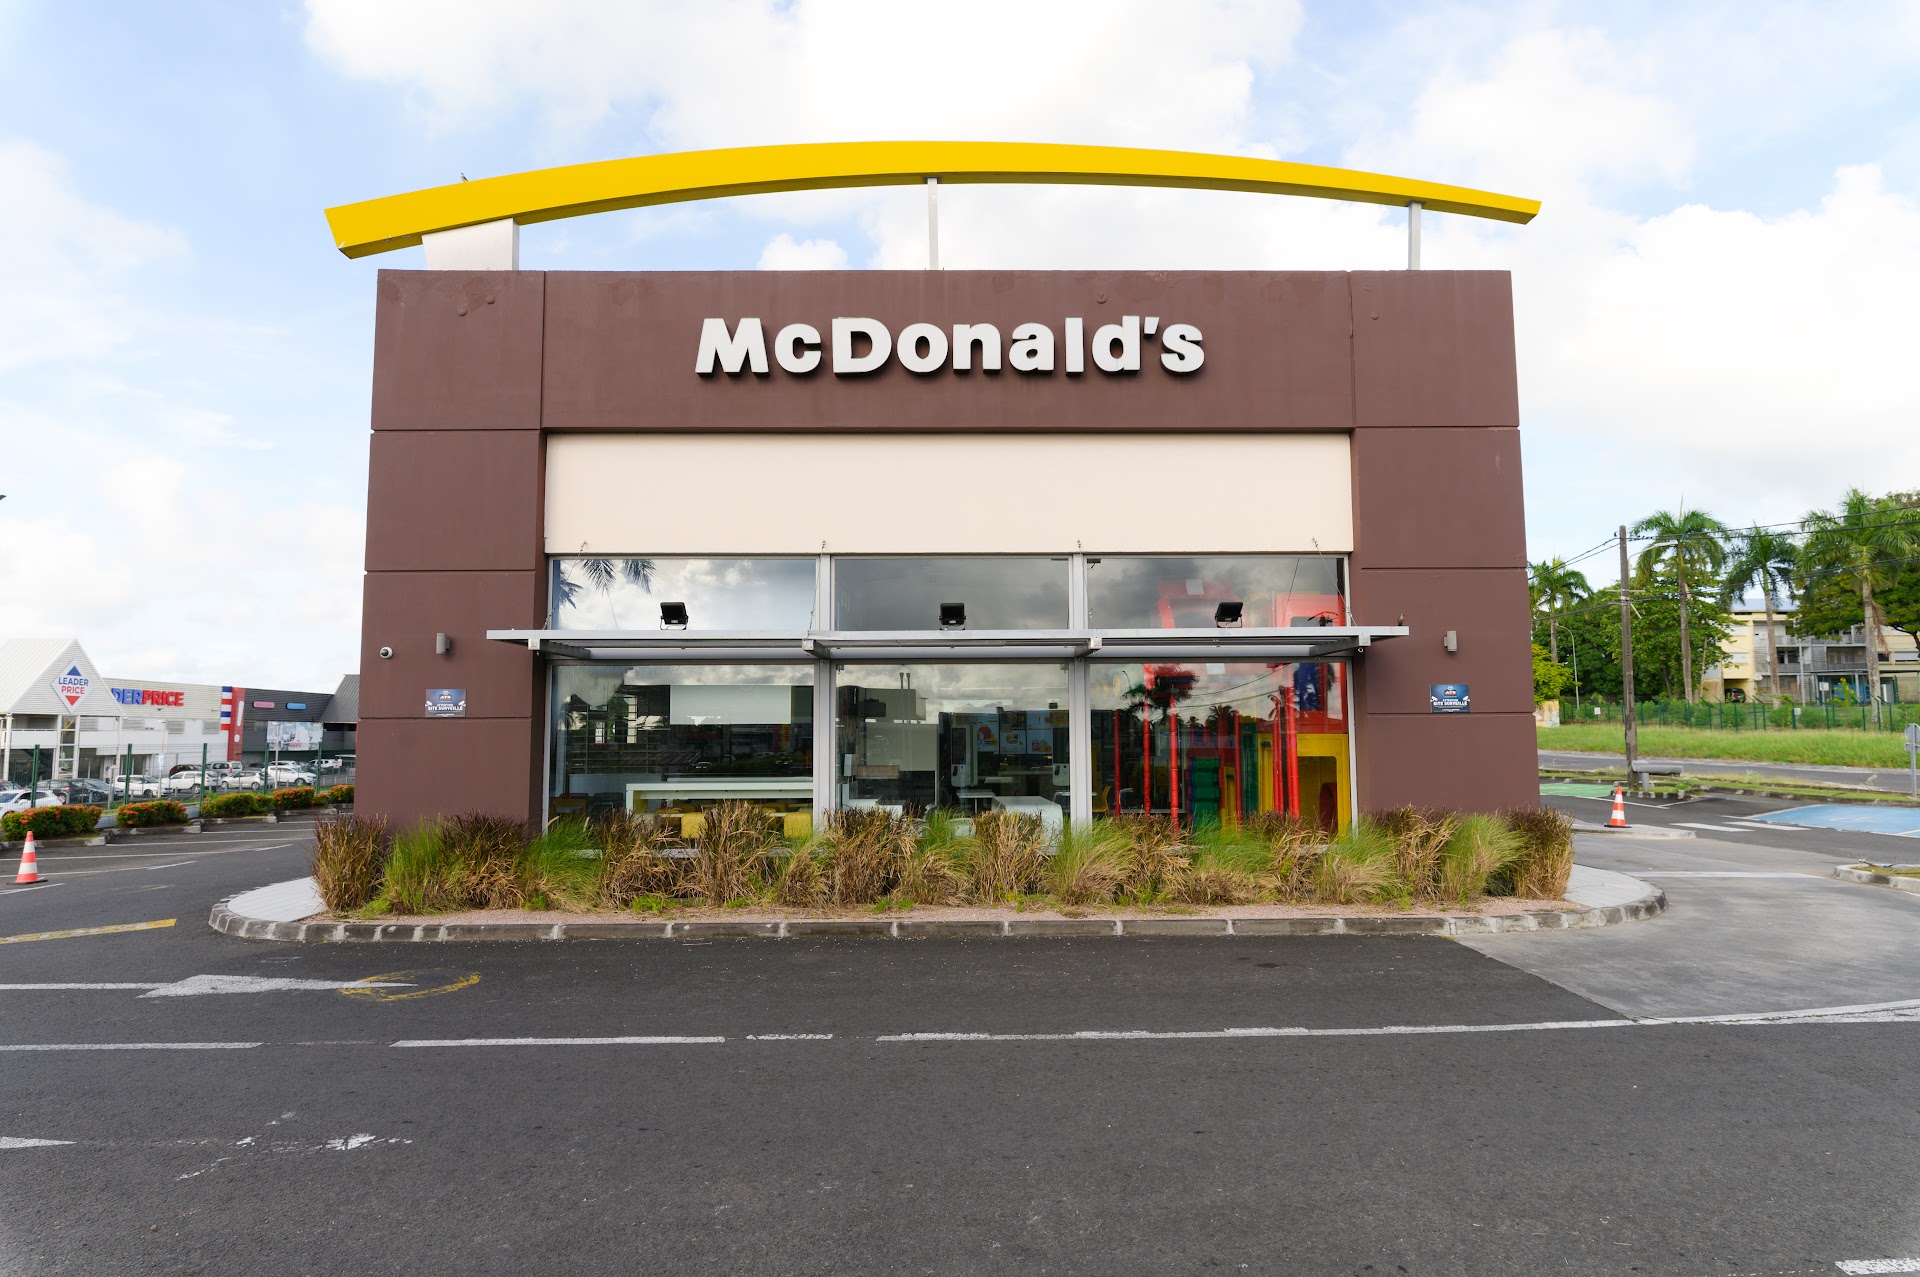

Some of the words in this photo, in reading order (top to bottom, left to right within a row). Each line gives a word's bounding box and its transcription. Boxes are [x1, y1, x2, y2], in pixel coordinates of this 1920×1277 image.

[694, 315, 1206, 376] McDonald's
[58, 677, 89, 686] LEADER
[61, 686, 85, 694] PRICE
